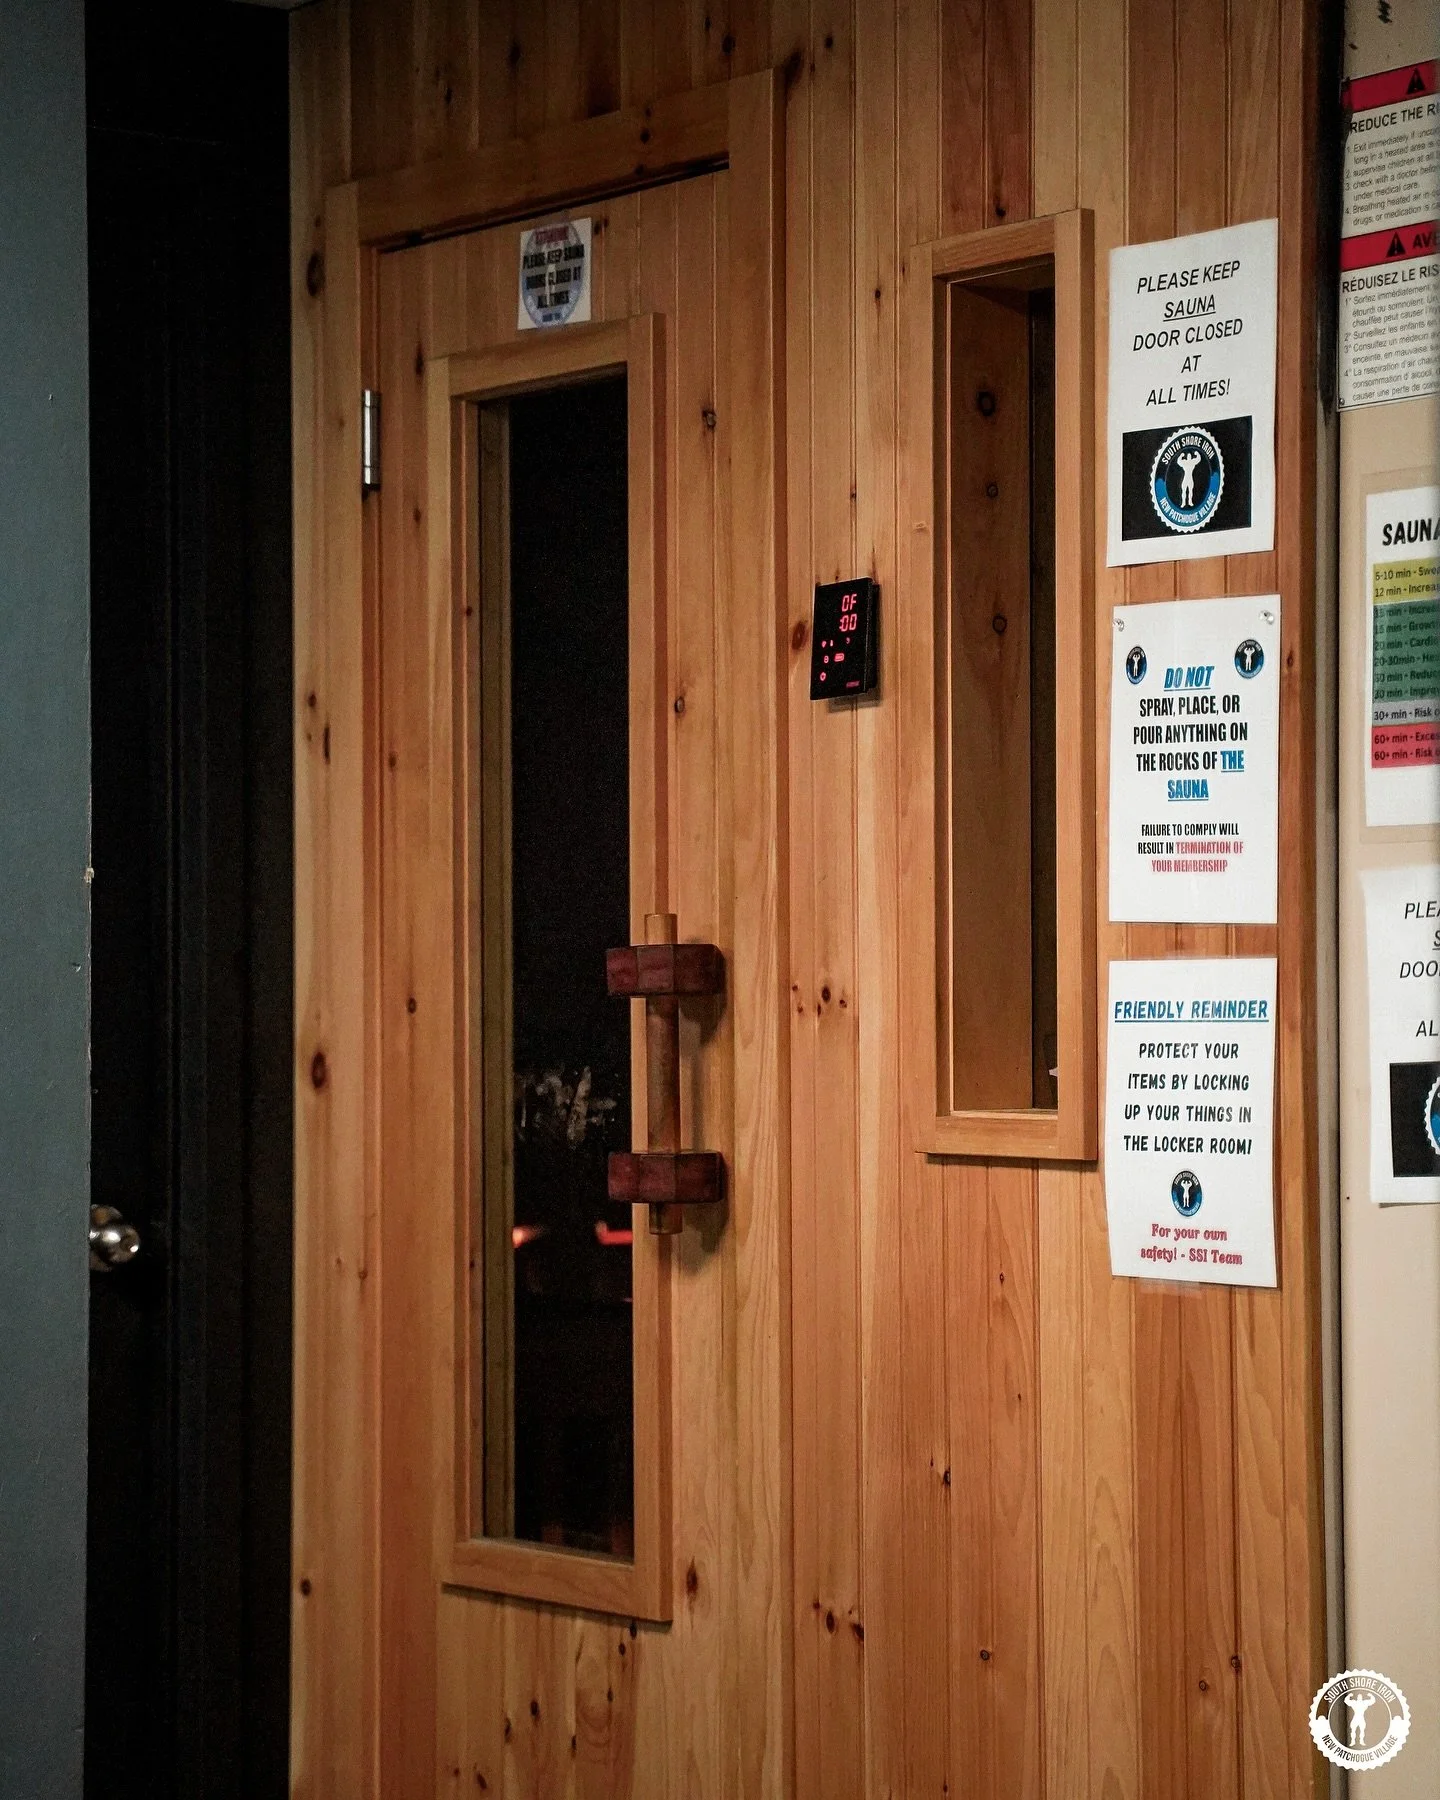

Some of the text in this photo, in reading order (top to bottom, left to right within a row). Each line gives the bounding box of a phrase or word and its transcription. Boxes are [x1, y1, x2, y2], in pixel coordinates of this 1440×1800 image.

[1350, 112, 1397, 134] REDUCE
[1400, 106, 1423, 122] THE
[1354, 135, 1408, 153] Exit immediately
[1353, 179, 1372, 190] check
[1375, 185, 1401, 197] medical
[1352, 201, 1385, 214] Breathing
[1386, 194, 1410, 207] heated
[1384, 206, 1421, 220] medication
[1137, 260, 1241, 294] PLEASE KEEP
[1342, 272, 1398, 294] RÉDUISEZ
[1402, 268, 1415, 282] LE
[1163, 294, 1216, 321] SAUNA
[1354, 294, 1375, 305] Sortez
[1133, 318, 1243, 351] DOOR CLOSED
[1353, 340, 1386, 353] Consultez
[1181, 354, 1201, 373] AT
[1364, 362, 1400, 375] respiration
[1146, 378, 1230, 406] ALL TIMES!
[1352, 391, 1375, 401] causer
[1162, 435, 1215, 465] SOUTH SHORE IRON
[1395, 567, 1411, 579] min
[1375, 587, 1384, 597] 12
[1386, 585, 1402, 596] min
[1164, 667, 1184, 690] DO
[1184, 666, 1215, 688] NOT
[1139, 694, 1240, 717] SPRAY, PLACE, OR
[1374, 706, 1432, 721] 30+ min Risk
[1133, 721, 1248, 745] POUR ANYTHING ON
[1374, 734, 1390, 745] 60+
[1392, 733, 1408, 743] min
[1136, 750, 1245, 772] THE ROCKS OF THE
[1374, 747, 1433, 761] 60+ min Risk
[1168, 778, 1209, 801] SAUNA
[1141, 822, 1239, 837] FAILURE TO COMPLY WILL
[1138, 841, 1244, 855] RESULT IN TERMINATION OF
[1151, 859, 1228, 872] YOUR MEMBERSHIP
[1115, 1000, 1268, 1020] FRIENDLY REMINDER
[1139, 1042, 1239, 1059] PROTECT YOUR
[1128, 1073, 1250, 1091] ITEMS BY LOCKING
[1124, 1104, 1252, 1123] UP YOUR THINGS IN
[1123, 1135, 1252, 1155] THE LOCKER ROOM!
[1151, 1223, 1227, 1241] For your own
[1140, 1245, 1177, 1263] safety!
[1189, 1247, 1208, 1263] SSI
[1211, 1249, 1243, 1265] Team
